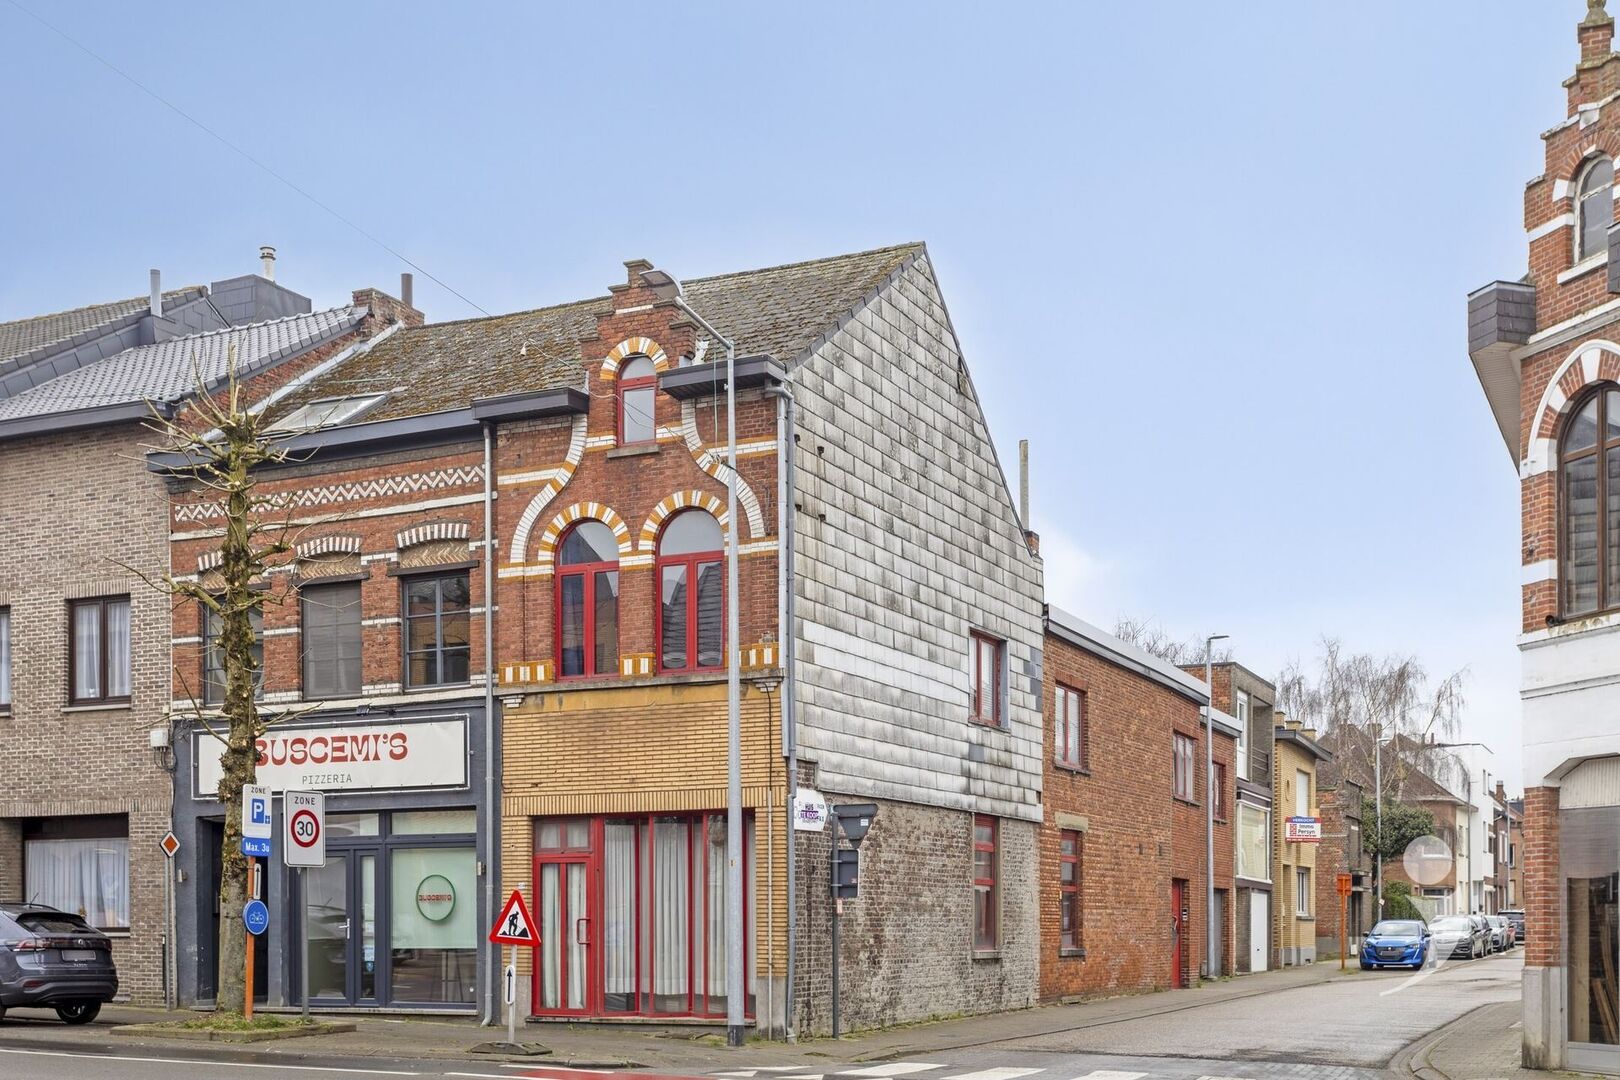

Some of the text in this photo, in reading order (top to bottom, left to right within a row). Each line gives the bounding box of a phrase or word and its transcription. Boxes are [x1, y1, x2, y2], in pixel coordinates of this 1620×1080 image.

[255, 732, 408, 767] BUSCEMI'S
[302, 774, 352, 785] PIZZERIA
[294, 796, 316, 805] ZONE
[253, 802, 263, 819] P
[296, 821, 314, 837] 30
[245, 842, 270, 852] Max. 3u
